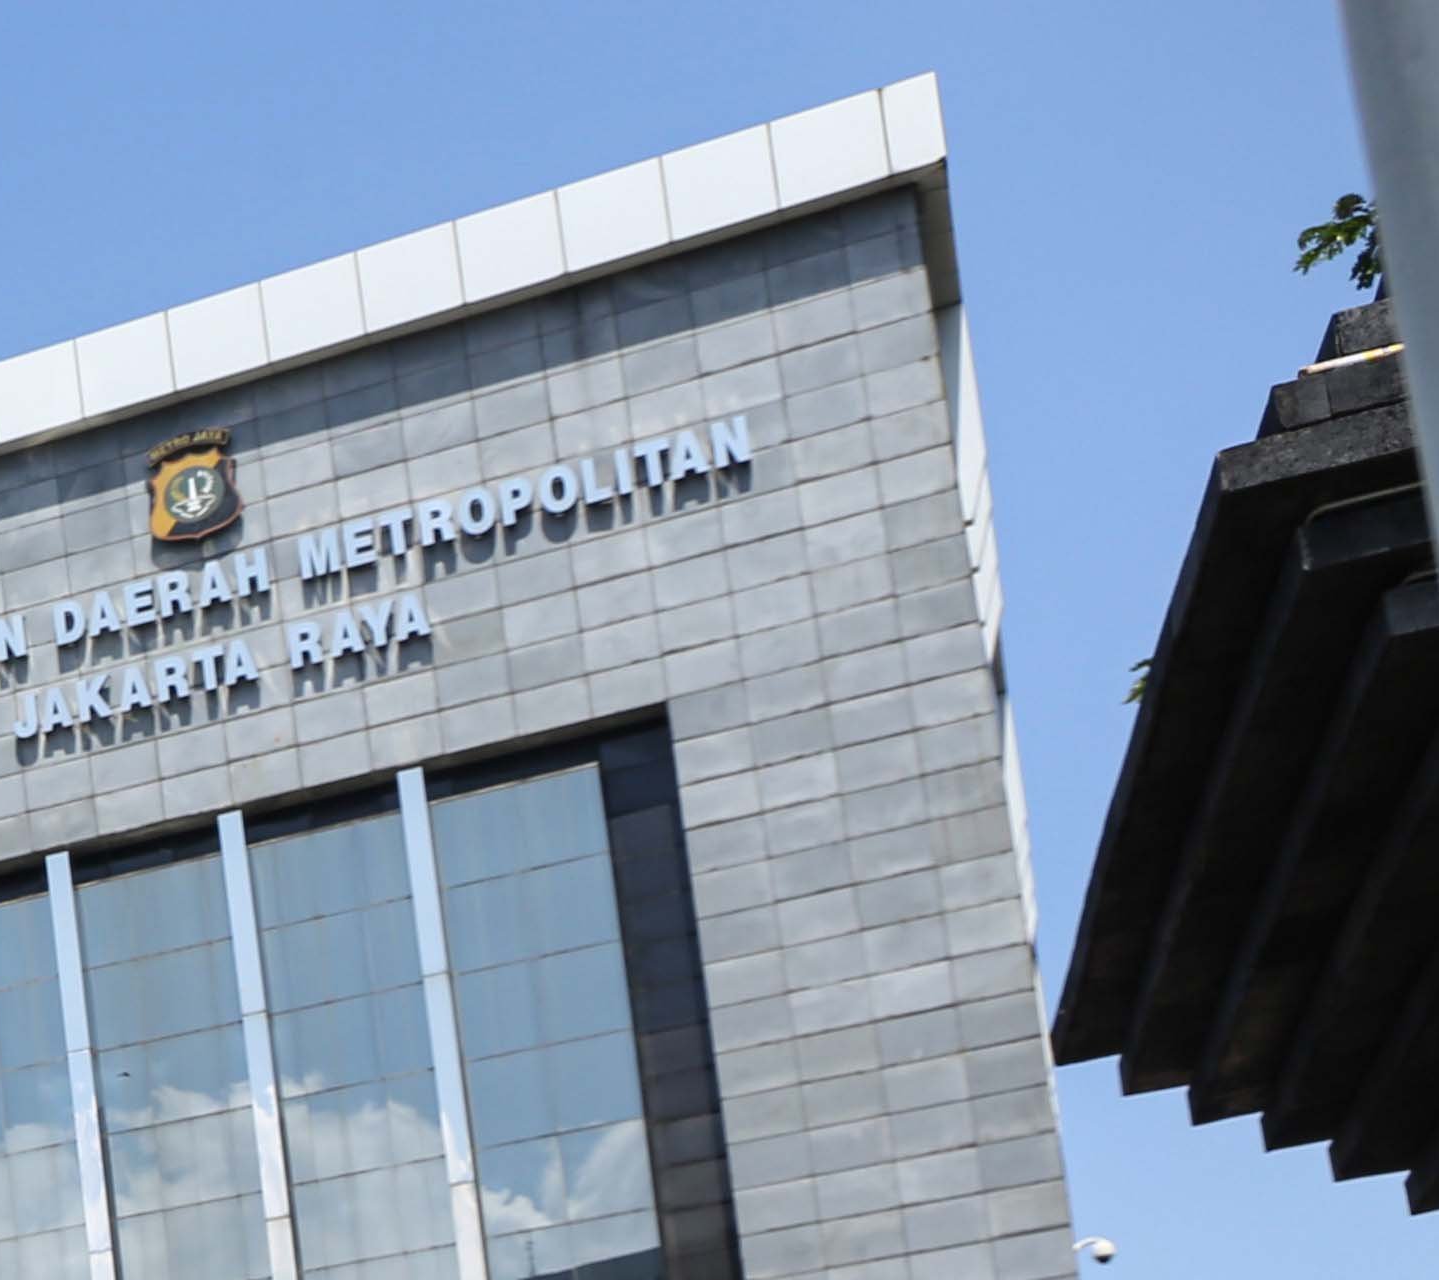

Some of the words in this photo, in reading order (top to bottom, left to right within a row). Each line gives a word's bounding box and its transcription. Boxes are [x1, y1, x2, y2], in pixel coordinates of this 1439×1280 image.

[53, 547, 271, 647] DAERAH
[297, 414, 753, 581] METROPOLITAN
[13, 638, 260, 739] JAKARTA
[287, 593, 432, 671] RAYA
